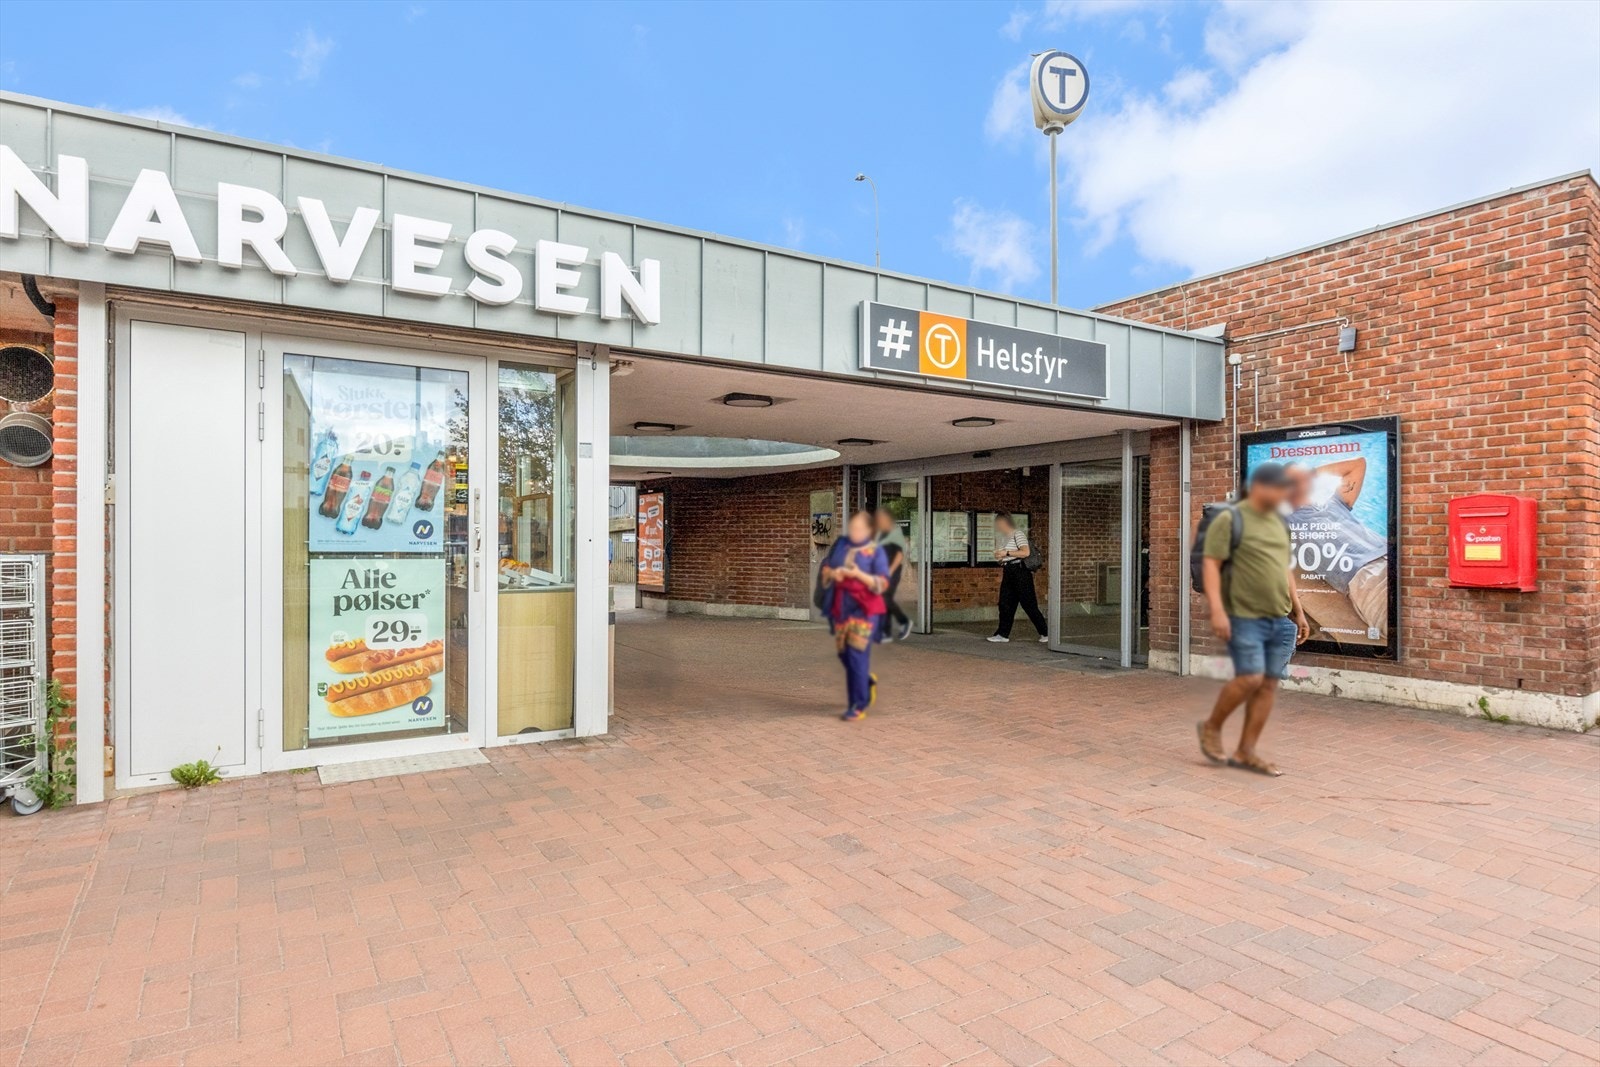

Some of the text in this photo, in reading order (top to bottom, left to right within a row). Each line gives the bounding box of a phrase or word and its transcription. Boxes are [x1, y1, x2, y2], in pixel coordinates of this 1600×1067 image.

[0, 144, 662, 325] NARVESEN
[977, 336, 1068, 384] Helsfyr
[1298, 430, 1326, 438] JCDecaux
[1270, 442, 1361, 458] Dressmann
[1299, 531, 1337, 540] SHORTS
[1474, 535, 1501, 543] posten
[340, 568, 397, 590] Alle
